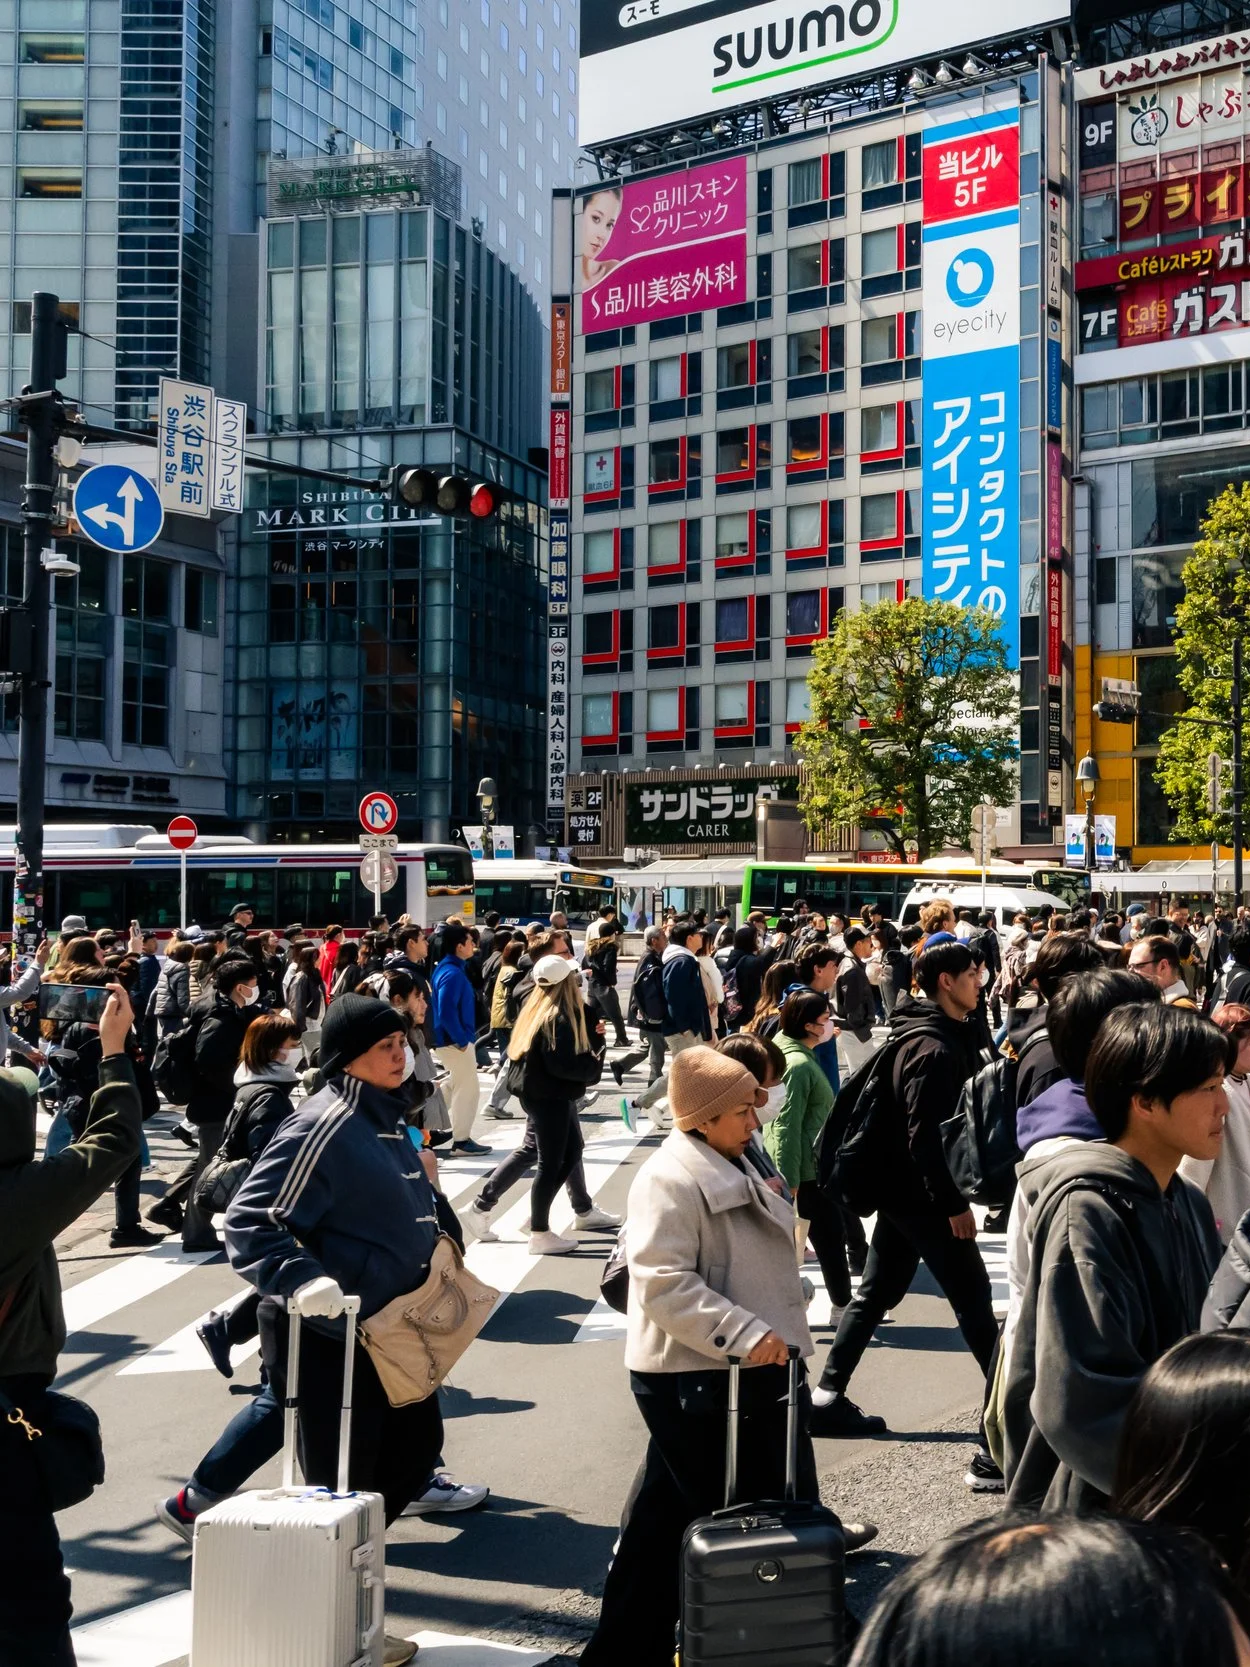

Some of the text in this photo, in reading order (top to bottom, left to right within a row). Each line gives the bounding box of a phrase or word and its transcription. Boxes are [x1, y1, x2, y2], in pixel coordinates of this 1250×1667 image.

[627, 1, 660, 22] スーモ
[1084, 120, 1113, 147] 9F
[938, 143, 1003, 180] 当ビル
[279, 174, 415, 196] MARK CITY
[653, 175, 738, 214] 品川スキン
[954, 177, 988, 208] 5F
[654, 202, 729, 239] クリニック
[1050, 219, 1059, 294] 献血ルーム
[604, 260, 738, 316] 品川美容外科
[1082, 308, 1118, 339] 7F
[1126, 299, 1168, 324] Café
[934, 309, 1007, 343] eyecity
[1127, 320, 1168, 337] レストラン
[555, 319, 566, 391] 東京スター銀行
[164, 407, 180, 487] Shibuya Sta.
[554, 412, 566, 458] 外貨両替
[180, 394, 206, 505] 渋谷駅前
[219, 404, 239, 508] スクランブル式
[302, 489, 392, 504] SHIBUYA
[979, 391, 1007, 620] コンタクトの
[1050, 463, 1060, 541] 品川美容外科
[256, 508, 350, 527] MARK
[305, 538, 385, 552] 渋谷 マークシティ
[551, 520, 567, 598] 加藤眼科
[551, 602, 566, 613] 5F
[551, 626, 566, 637] 3F
[551, 660, 565, 685] 内科
[550, 691, 565, 801] 産婦人科・心療内科
[571, 789, 584, 808] 薬
[587, 791, 601, 805] 2F
[569, 815, 601, 828] 処方せん
[578, 828, 594, 842] 受付
[687, 824, 730, 837] CARER
[362, 838, 396, 848] ここまで
[871, 855, 917, 864] 東京スター行
